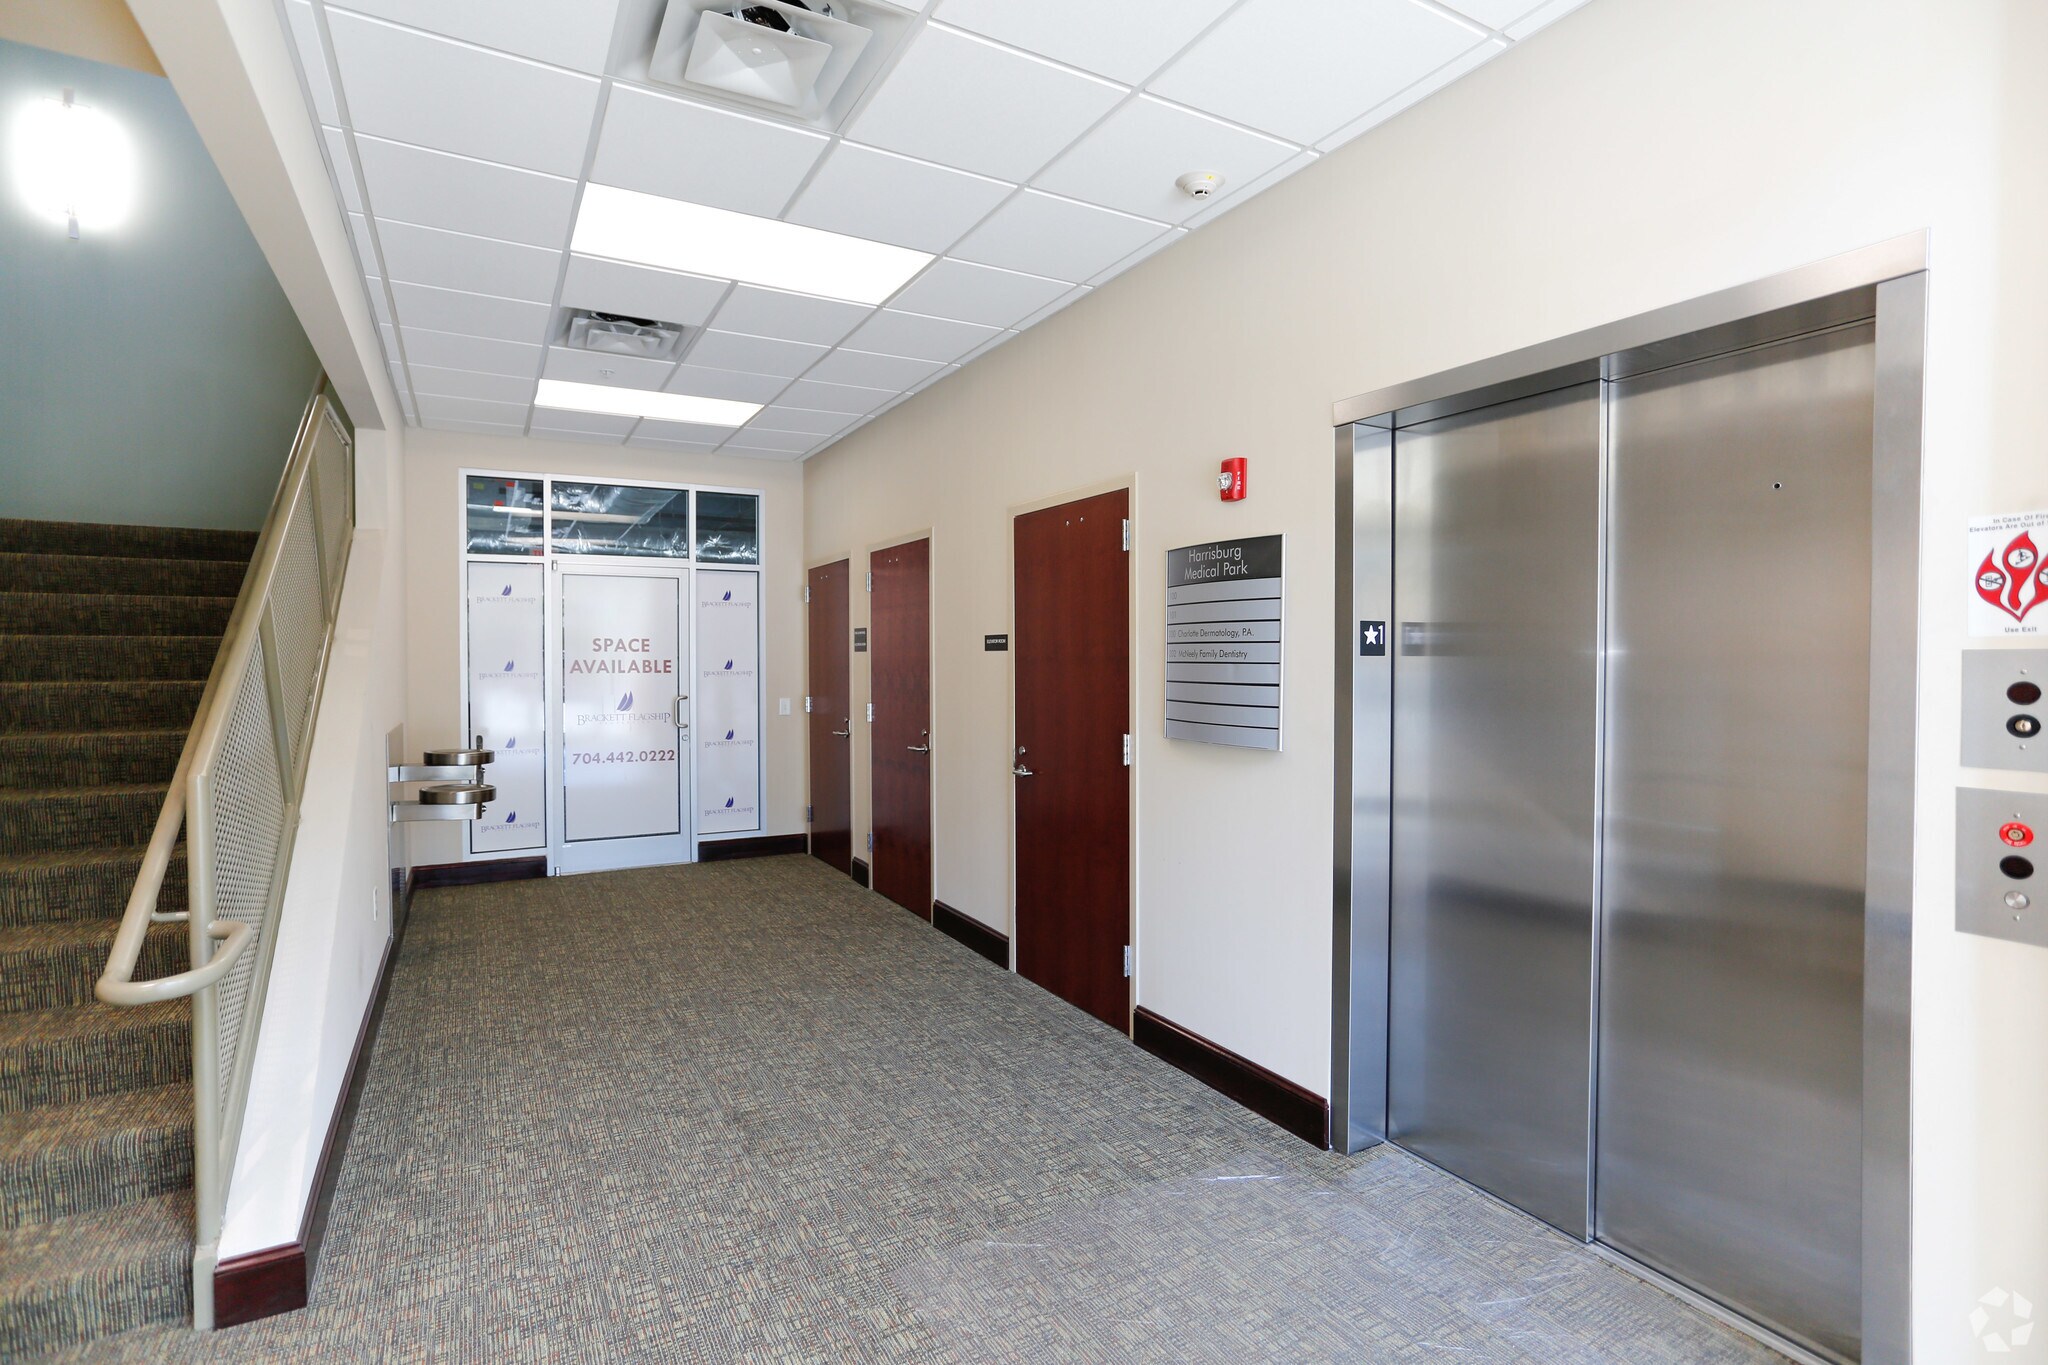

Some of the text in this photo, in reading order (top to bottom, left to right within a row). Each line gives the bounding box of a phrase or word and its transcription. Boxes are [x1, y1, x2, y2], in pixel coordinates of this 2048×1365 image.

[1969, 525, 2003, 533] Elevators
[1188, 545, 1242, 563] Harrisburg
[1184, 559, 1248, 580] Medical Park
[1200, 628, 1240, 639] Dermatology,
[1242, 627, 1255, 637] P.A.
[1377, 625, 1384, 645] 1
[592, 638, 650, 652] SPACE
[1199, 649, 1218, 659] Family
[1219, 649, 1248, 660] Dentistry
[569, 659, 672, 674] AVAILABLE
[577, 712, 671, 726] BRACKETT FLAGSHIP
[572, 749, 675, 765] 704.442.0222
